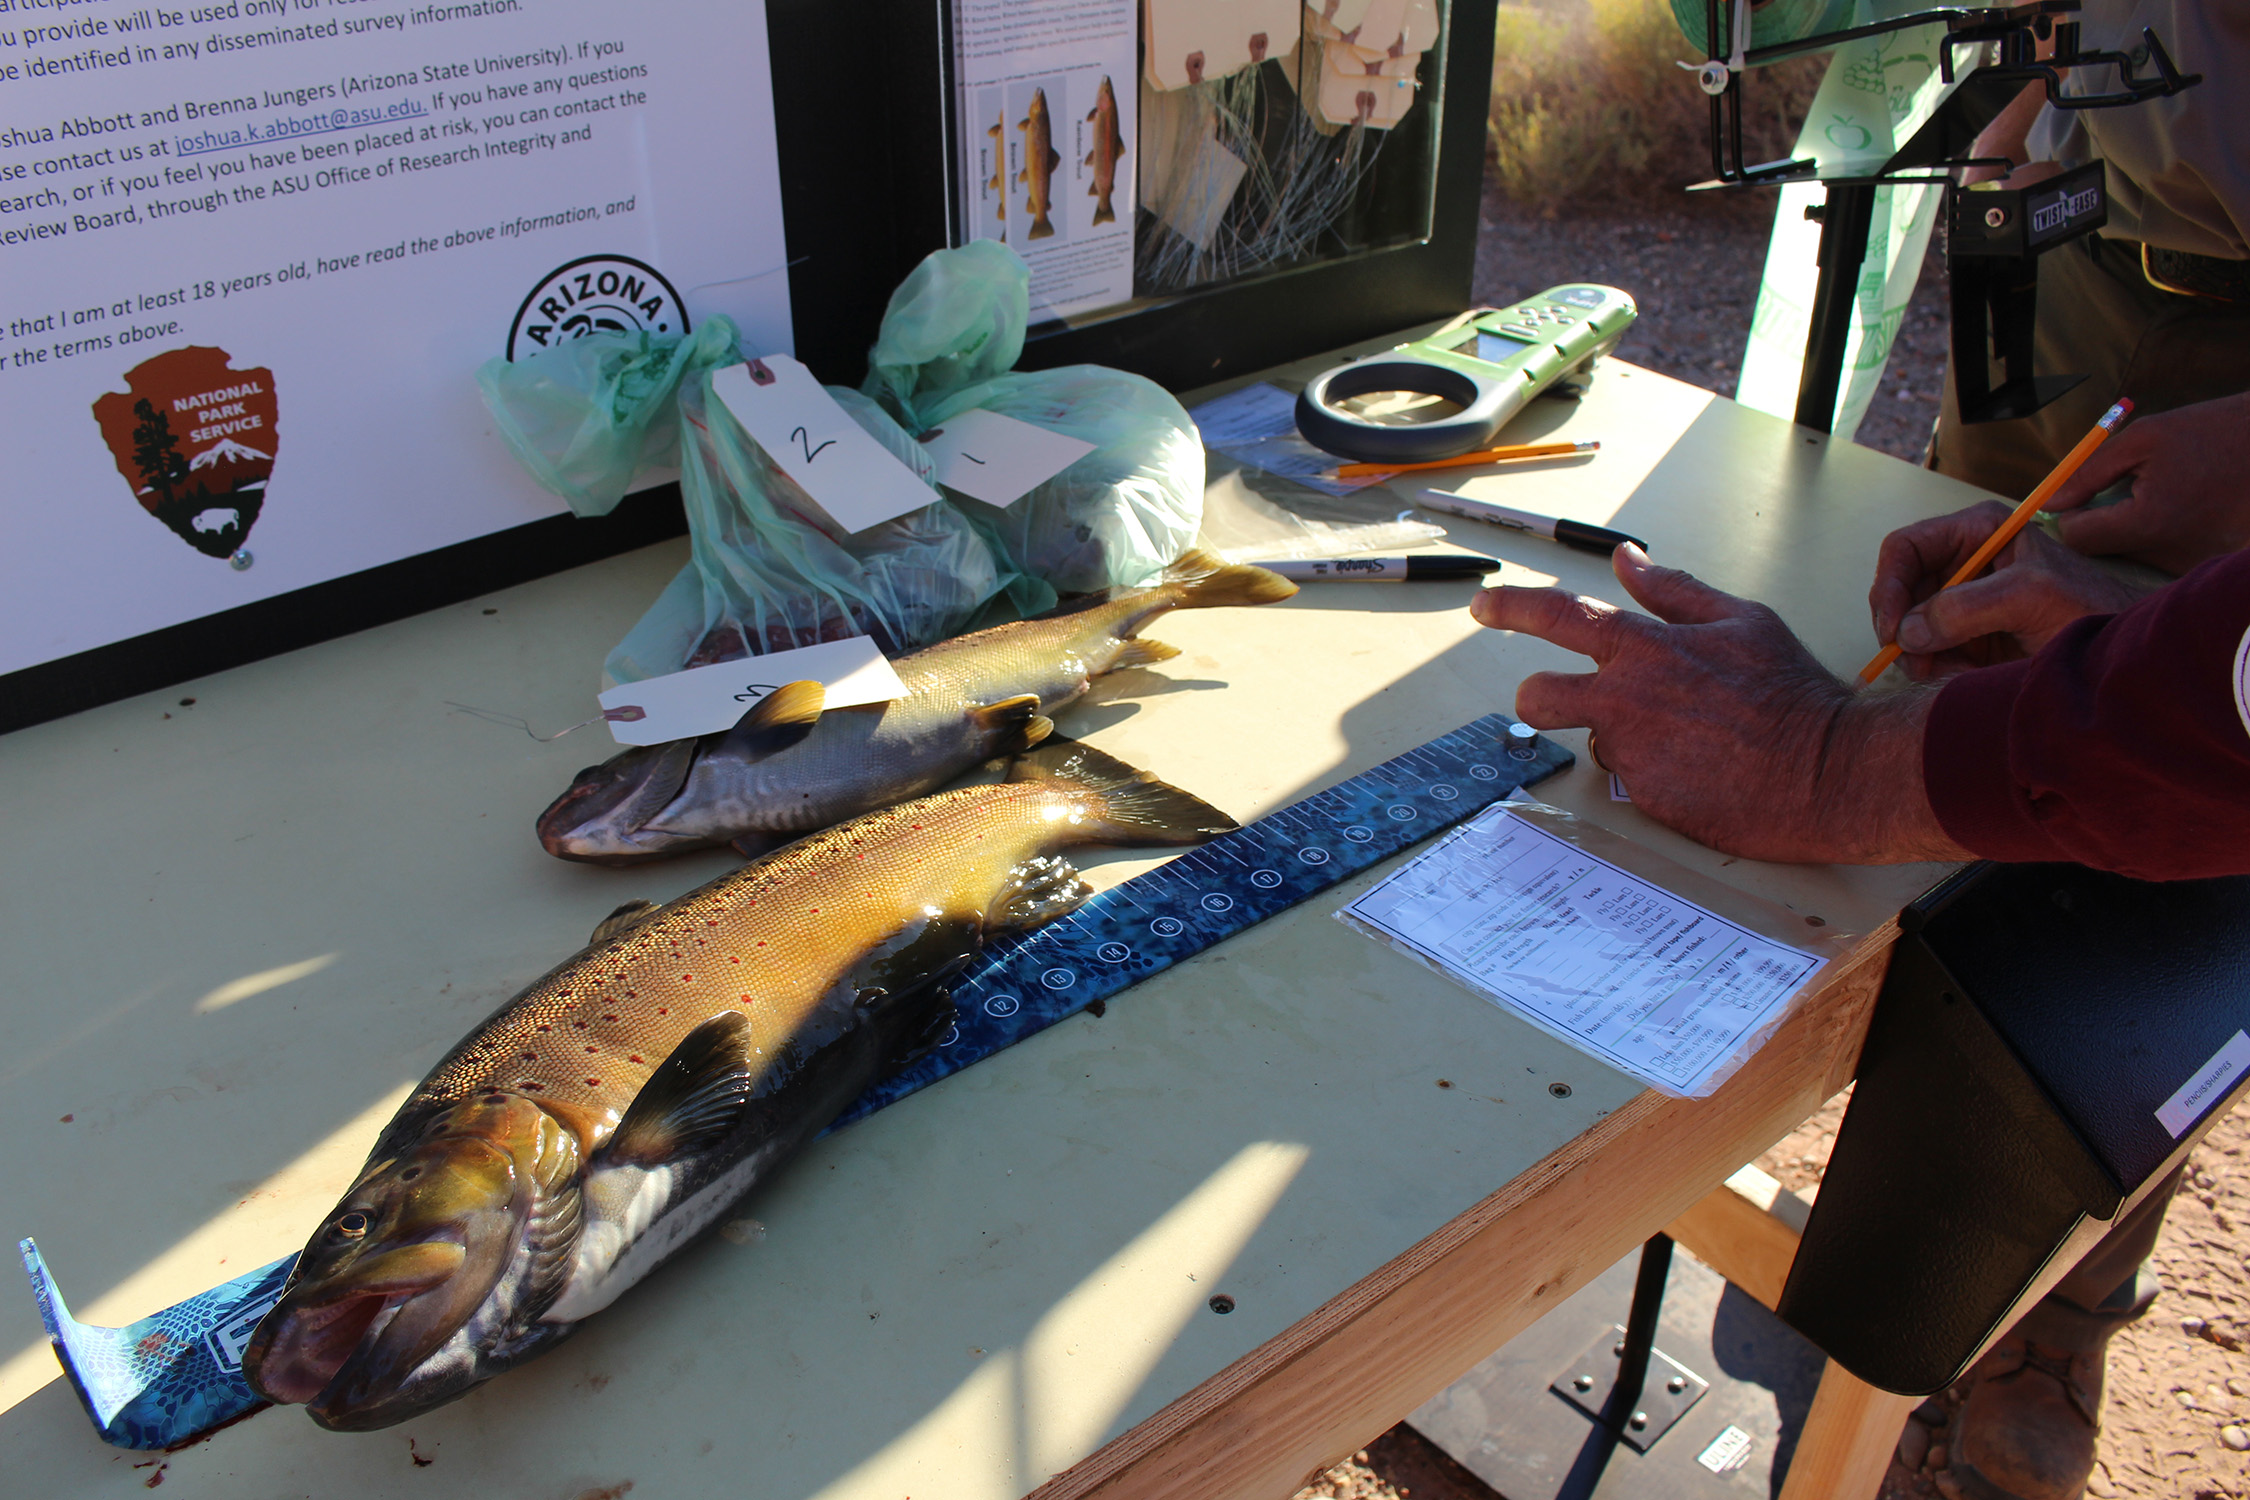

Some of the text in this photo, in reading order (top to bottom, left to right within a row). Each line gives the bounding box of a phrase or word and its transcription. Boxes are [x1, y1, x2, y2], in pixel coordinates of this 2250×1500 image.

[0, 31, 17, 46] u
[22, 16, 108, 47] provide
[113, 9, 152, 32] will
[156, 8, 184, 27] be
[189, 0, 239, 23] used
[244, 0, 286, 16] only
[23, 45, 131, 77] identified
[135, 44, 157, 62] in
[162, 41, 199, 59] any
[205, 17, 338, 53] disseminated
[343, 13, 404, 34] survey
[409, 0, 522, 24] information.
[0, 40, 623, 148] shua Abbott and Brenna Jungers (Arizona State University). If you
[0, 64, 647, 181] se contact us at joshua.k.abbott@asu.edu. If you have any questions
[0, 90, 646, 213] earch, or if you feel you have been placed at risk, you can contact the
[0, 123, 591, 245] eview Board, through the ASU Office of Research Integrity and
[9, 314, 54, 337] that
[61, 310, 66, 327] I
[73, 306, 105, 324] am
[111, 299, 132, 317] at
[138, 287, 185, 311] least
[192, 280, 215, 300] 18
[220, 272, 272, 298] years
[277, 260, 311, 282] old,
[317, 254, 360, 274] have
[365, 240, 405, 264] read
[410, 237, 438, 255] the
[443, 226, 495, 248] above
[500, 206, 600, 237] information,
[605, 194, 635, 215] and
[526, 270, 664, 348] ARIZONA
[12, 347, 47, 367] the
[53, 334, 112, 358] terms
[118, 321, 183, 345] above.
[173, 382, 263, 412] NATIONAL
[198, 402, 246, 424] PARK
[190, 415, 263, 443] SERVICE
[790, 426, 837, 464] 2
[1331, 558, 1387, 575] Sharpie
[1477, 768, 1491, 777] 22
[1436, 788, 1451, 797] 21
[1395, 808, 1410, 818] 20
[1351, 829, 1366, 839] 19
[1307, 850, 1322, 861] 18
[1260, 873, 1274, 884] 17
[1210, 897, 1225, 908] 16
[1159, 921, 1174, 932] 15
[1106, 947, 1121, 958] 14
[1051, 974, 1067, 985] 13
[994, 1000, 1011, 1013] 12
